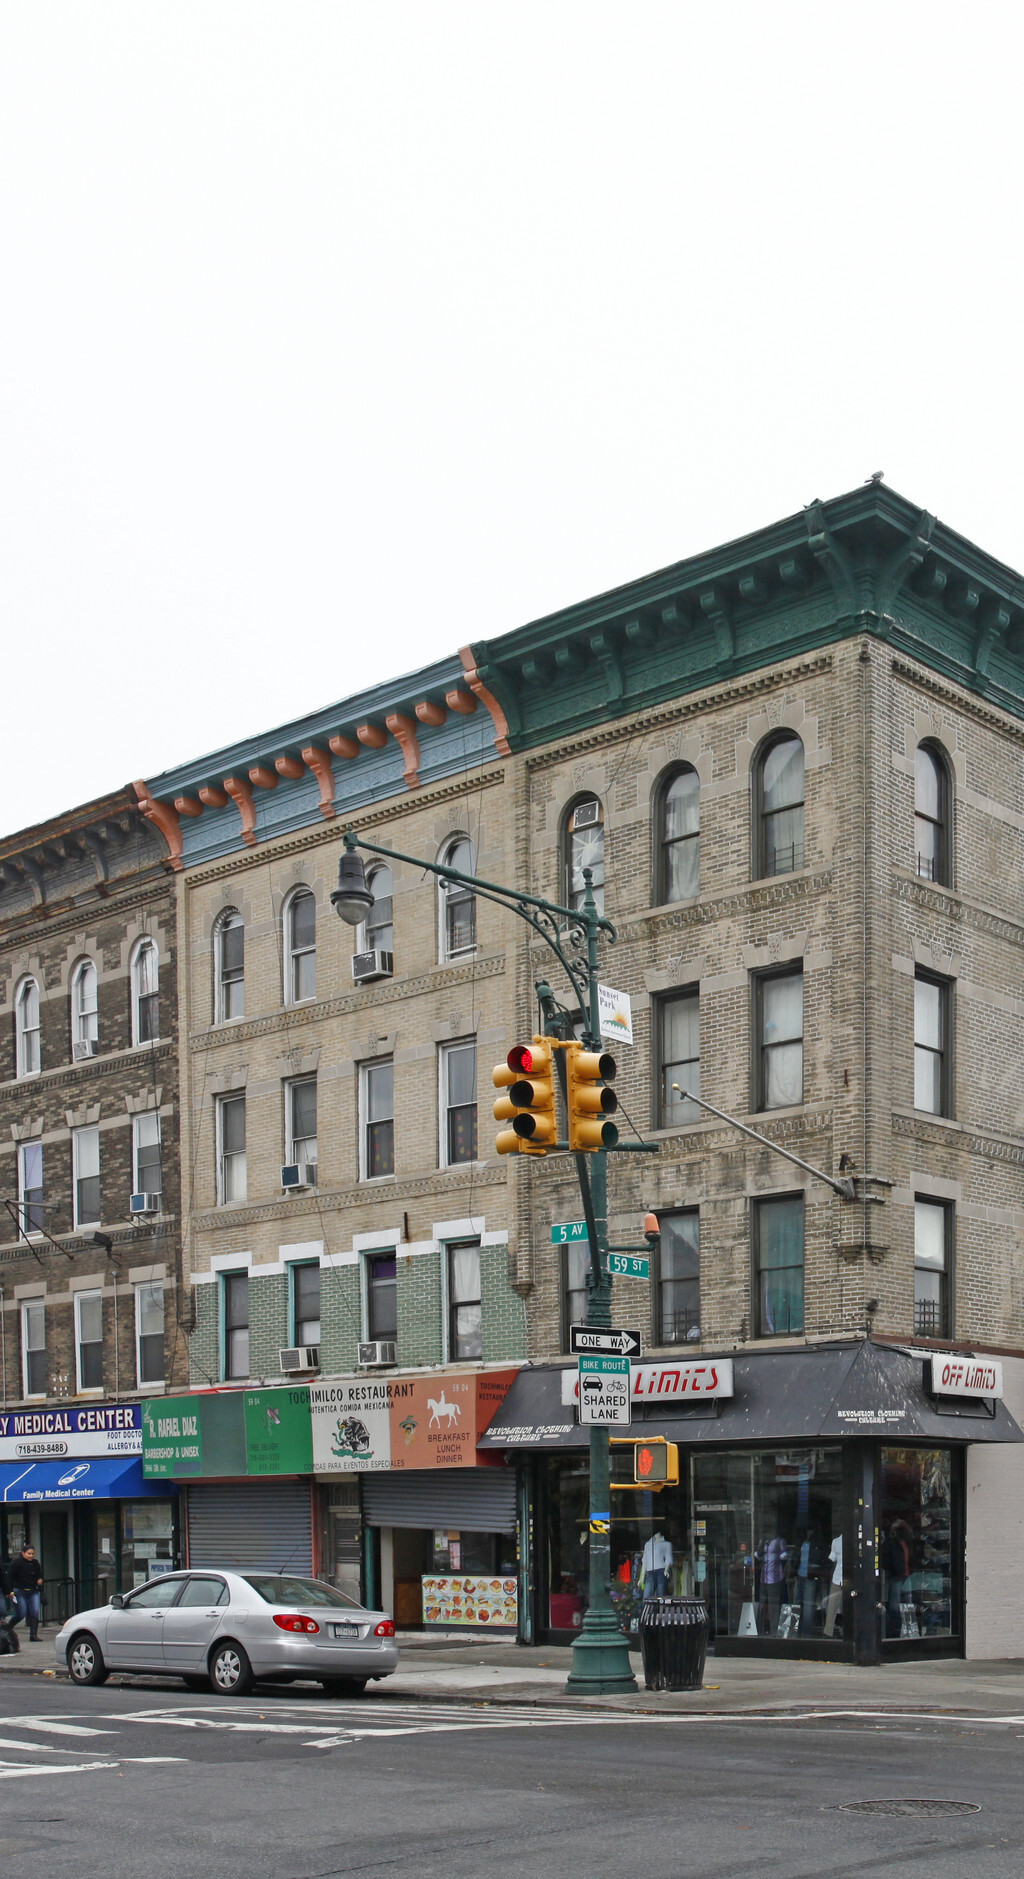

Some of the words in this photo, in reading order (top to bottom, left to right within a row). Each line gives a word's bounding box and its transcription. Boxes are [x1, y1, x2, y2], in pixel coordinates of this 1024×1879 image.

[599, 986, 619, 1001] Sunset
[600, 997, 616, 1010] Park
[560, 1226, 567, 1241] 5
[571, 1224, 583, 1235] AV
[614, 1257, 628, 1272] 59
[632, 1260, 643, 1271] ST
[581, 1335, 601, 1347] ONE
[610, 1337, 631, 1349] WAY
[582, 1360, 599, 1369] BIKE
[602, 1361, 626, 1371] ROUTE
[941, 1364, 964, 1387] OFF
[452, 1384, 459, 1392] 59
[462, 1383, 469, 1391] 04
[288, 1388, 343, 1405] TOCHIMILCO
[349, 1383, 415, 1400] RESTAURANT
[583, 1395, 627, 1407] SHARED
[308, 1404, 338, 1414] AUTENTICA
[339, 1403, 362, 1412] COMIDA
[364, 1401, 394, 1410] MEXICANA
[877, 1409, 906, 1417] CLOTHING
[591, 1409, 619, 1420] LANE
[14, 1413, 72, 1434] MEDICAL
[77, 1409, 134, 1431] CENTER
[158, 1418, 181, 1437] RAFAEL
[182, 1416, 198, 1436] DIAZ
[107, 1432, 121, 1440] FOOT
[485, 1426, 534, 1435] REVOLUTION
[535, 1425, 574, 1434] CLOTHING
[427, 1432, 470, 1443] BREAKFAST
[506, 1433, 542, 1442] CULTURE
[18, 1443, 64, 1454] 718-439-8488
[144, 1447, 174, 1459] BARBERSHOP
[175, 1447, 180, 1458] &
[180, 1446, 199, 1458] UNISEX
[437, 1444, 461, 1453] LUNCH
[327, 1462, 342, 1470] PARA
[343, 1461, 369, 1469] EVENTOS
[371, 1459, 405, 1468] ESPECIALES
[436, 1455, 463, 1464] DINNER
[23, 1491, 44, 1500] Family
[45, 1489, 71, 1498] Medical
[71, 1488, 95, 1497] Center
